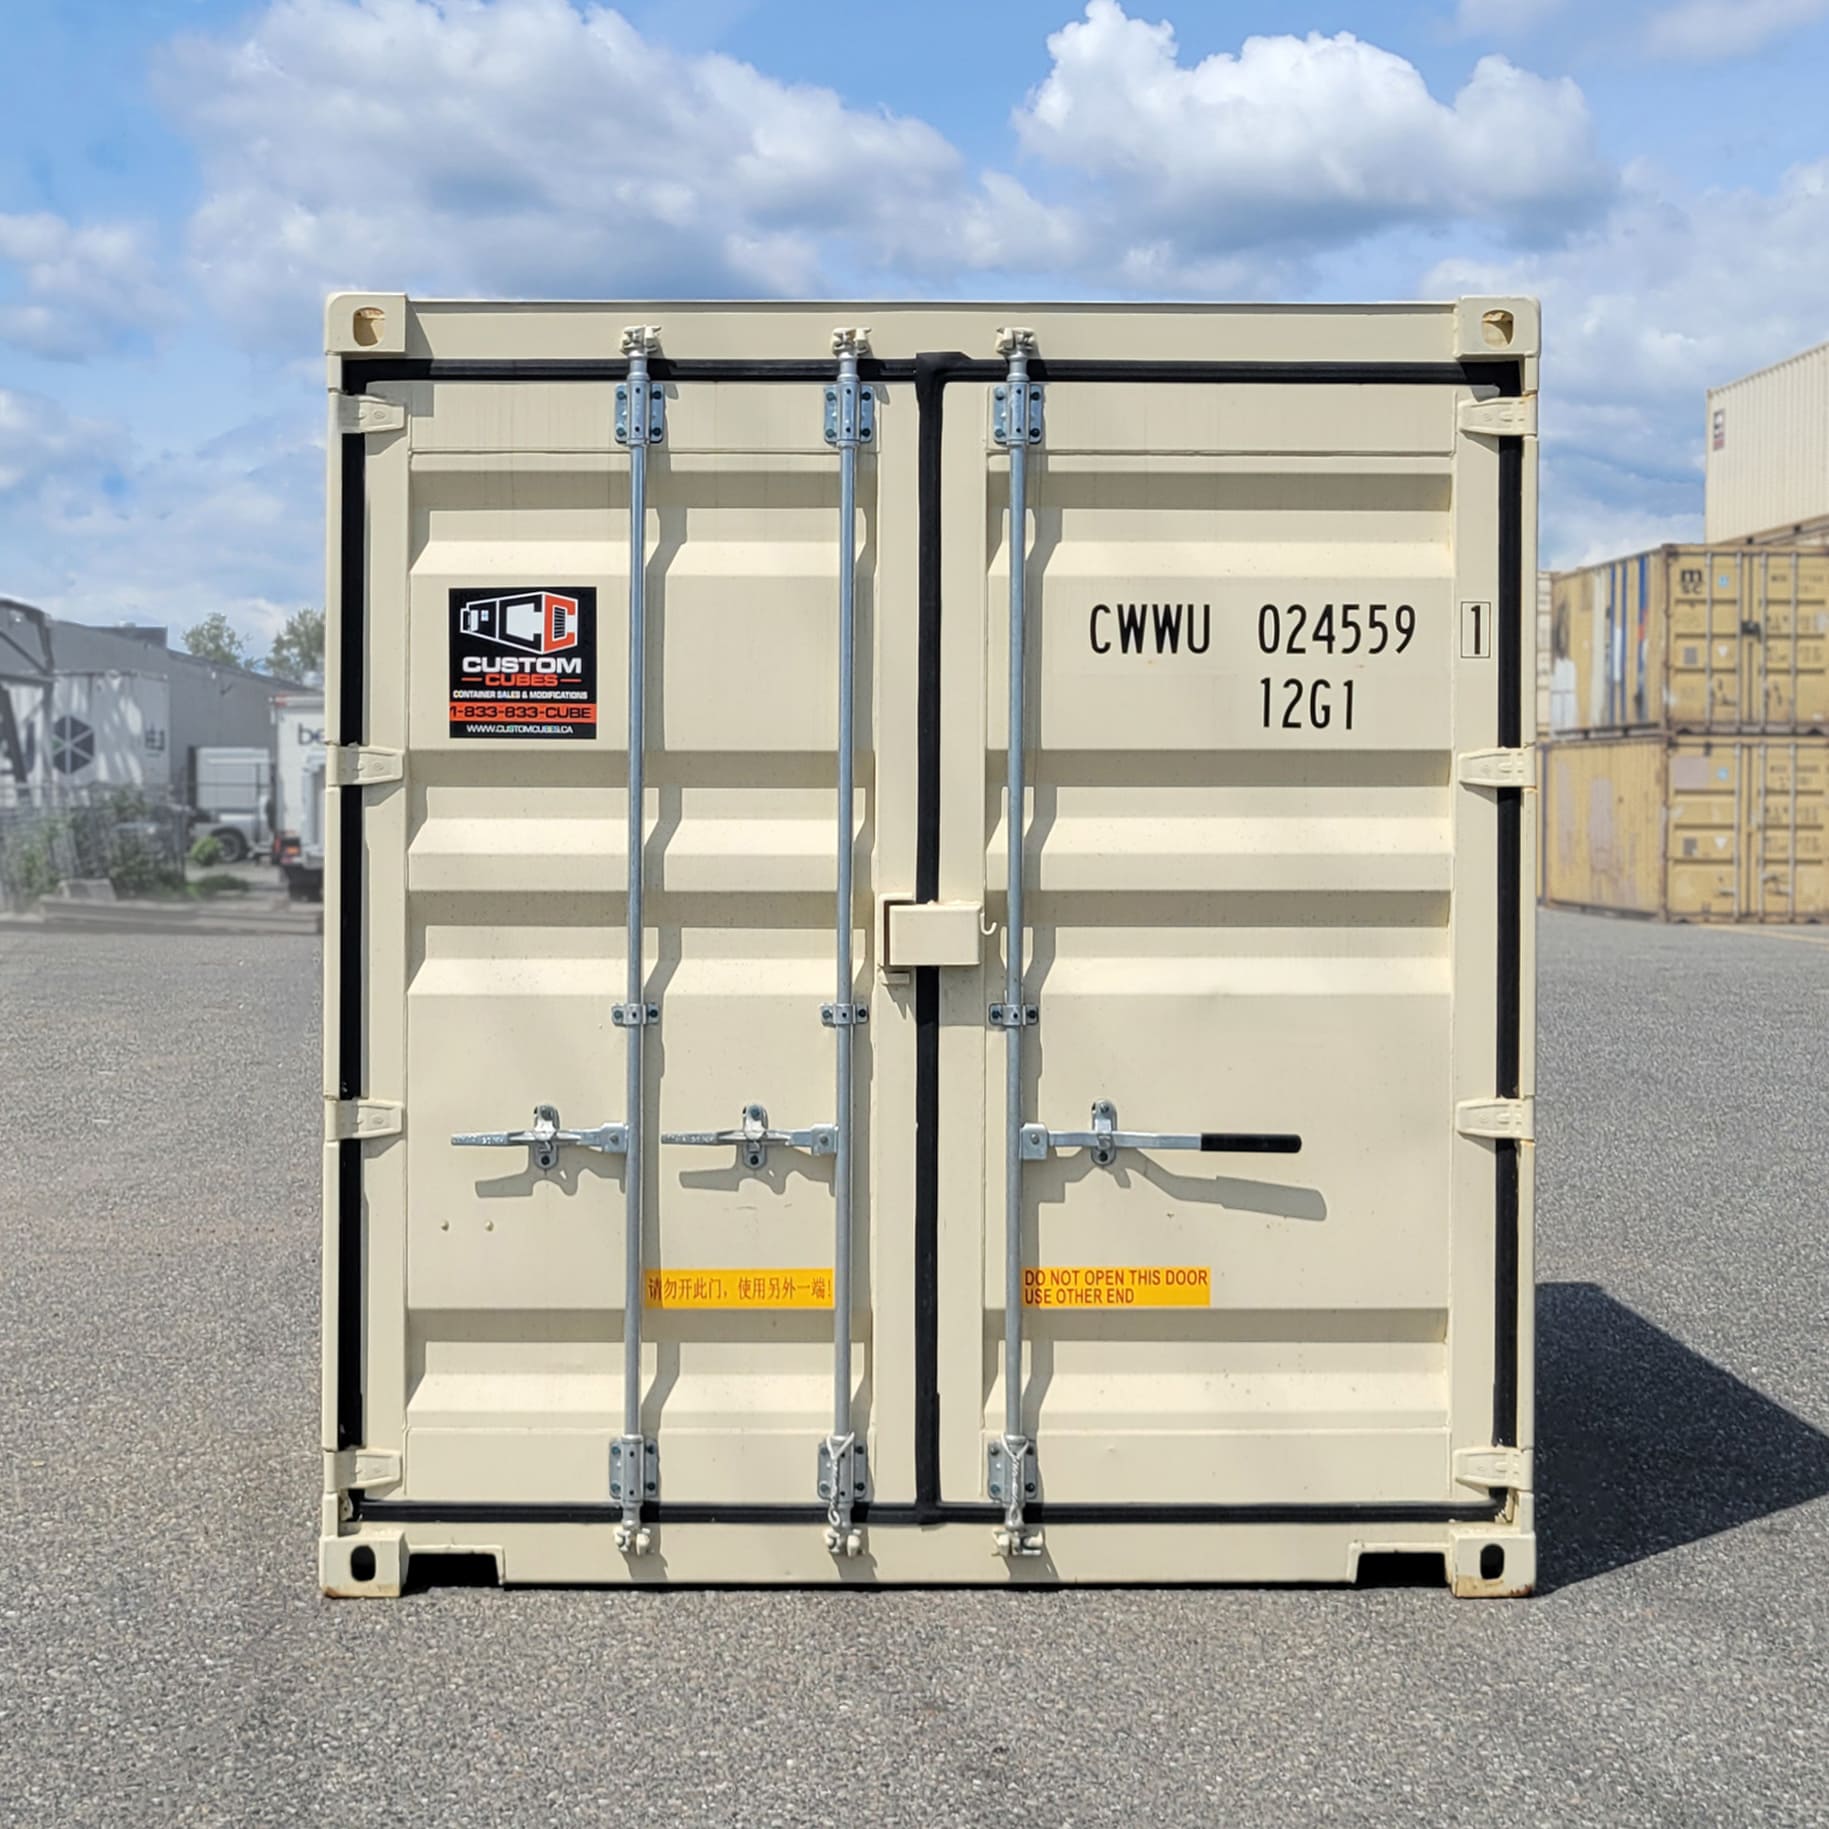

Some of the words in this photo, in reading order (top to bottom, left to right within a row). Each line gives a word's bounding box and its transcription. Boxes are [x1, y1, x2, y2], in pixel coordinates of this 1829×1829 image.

[1089, 604, 1211, 654] CWWU
[1258, 604, 1416, 654] 024559
[1470, 605, 1482, 655] 1
[462, 656, 582, 674] CUSTOM
[485, 673, 558, 687] CUBES
[453, 690, 496, 699] CONTAINER
[497, 690, 520, 699] SALES
[522, 690, 528, 699] &
[529, 691, 588, 700] MODIFICATIONS
[1260, 678, 1354, 730] 12G1
[450, 706, 591, 719] 1-833-833-CUBE
[1025, 1270, 1045, 1286] DO
[1050, 1270, 1080, 1286] NOT
[1084, 1270, 1124, 1286] OPEN
[1129, 1270, 1161, 1286] THIS
[1165, 1270, 1208, 1286] DOOR
[1025, 1288, 1052, 1304] USE
[1056, 1288, 1103, 1304] OTHER
[1107, 1288, 1134, 1304] END
